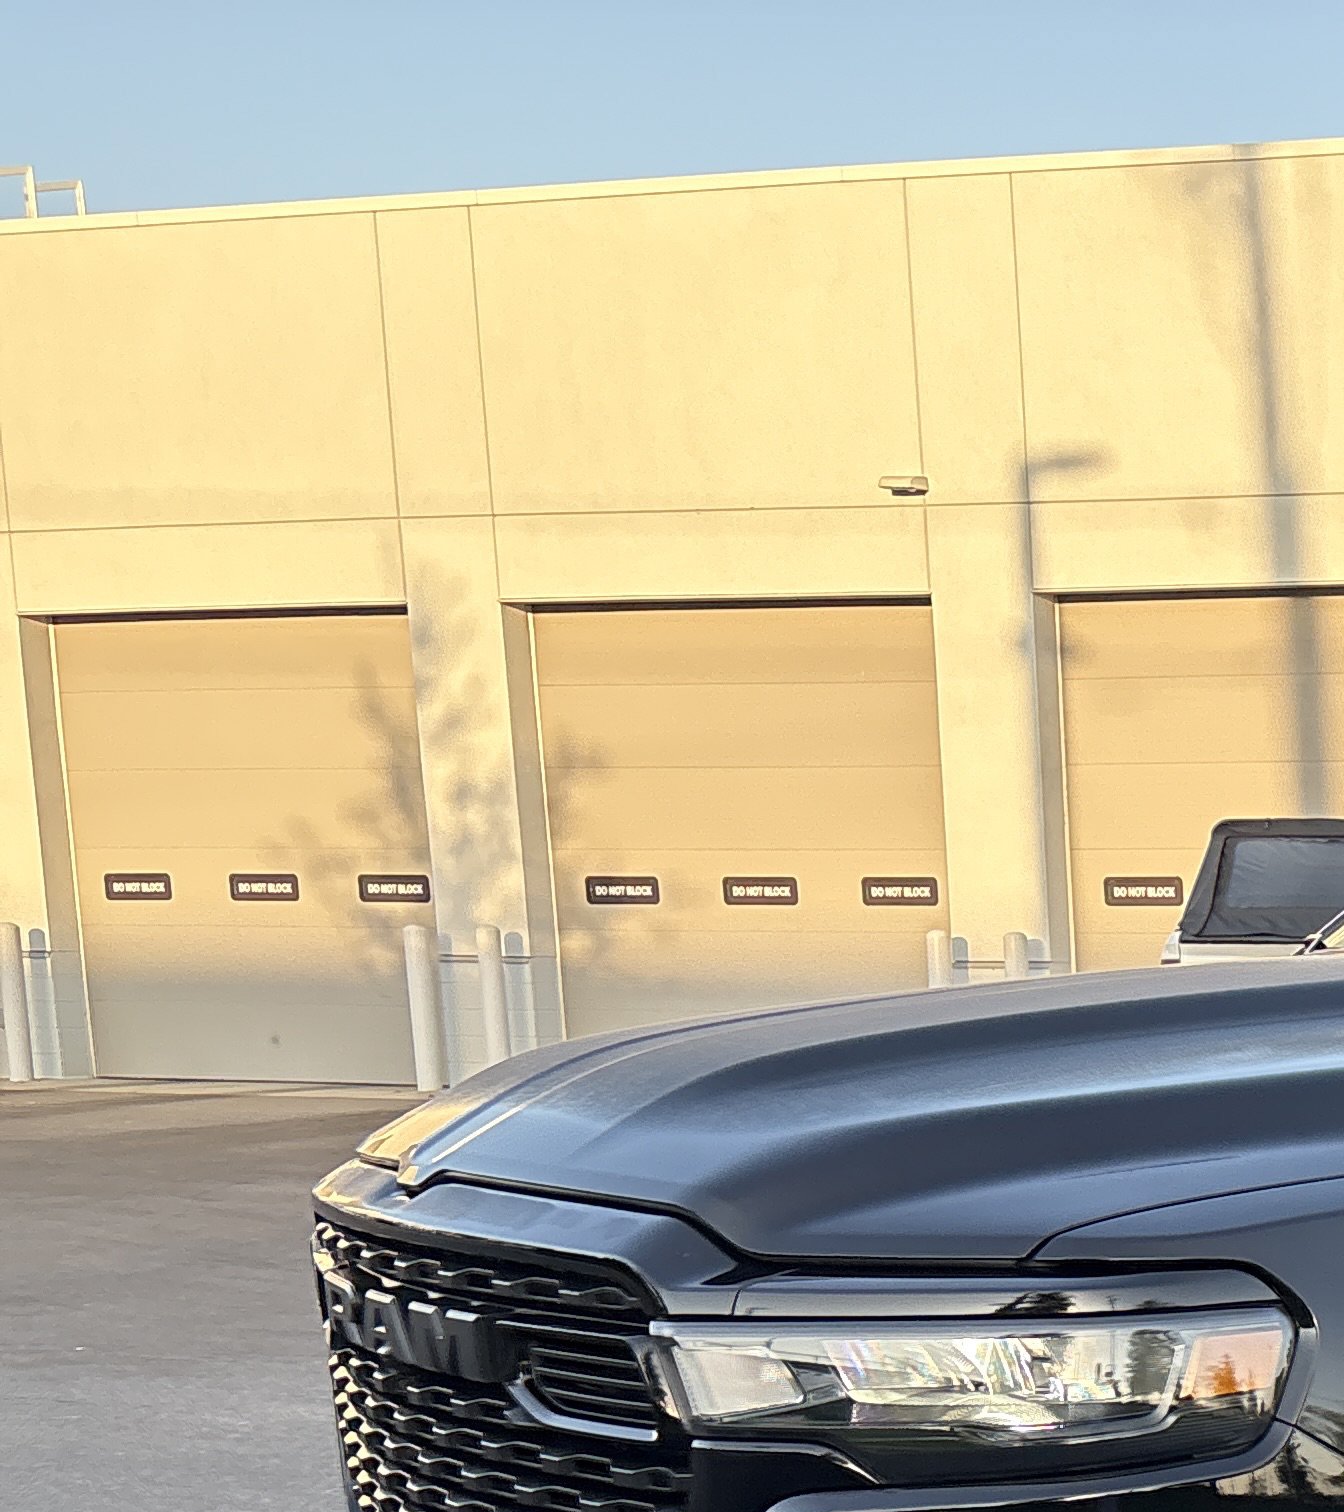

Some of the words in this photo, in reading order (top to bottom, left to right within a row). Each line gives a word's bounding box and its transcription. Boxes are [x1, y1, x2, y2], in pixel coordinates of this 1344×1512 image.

[113, 882, 124, 892] DO
[125, 882, 140, 892] NOT
[141, 882, 165, 892] BLOCK
[238, 883, 250, 893] DO
[251, 883, 266, 893] NOT
[267, 883, 292, 893] BLOCK
[367, 884, 380, 894] DO
[381, 884, 397, 894] NOT
[398, 884, 423, 894] BLOCK
[595, 886, 607, 896] DO
[608, 886, 625, 896] NOT
[626, 886, 652, 896] BLOCK
[732, 886, 745, 896] DO
[746, 886, 763, 896] NOT
[764, 886, 791, 896] BLOCK
[871, 887, 884, 897] DO
[885, 887, 902, 897] NOT
[903, 887, 931, 897] BLOCK
[1113, 887, 1127, 897] DO
[1128, 887, 1146, 897] NOT
[1147, 887, 1175, 897] BLOCK
[323, 1271, 499, 1382] RAM
